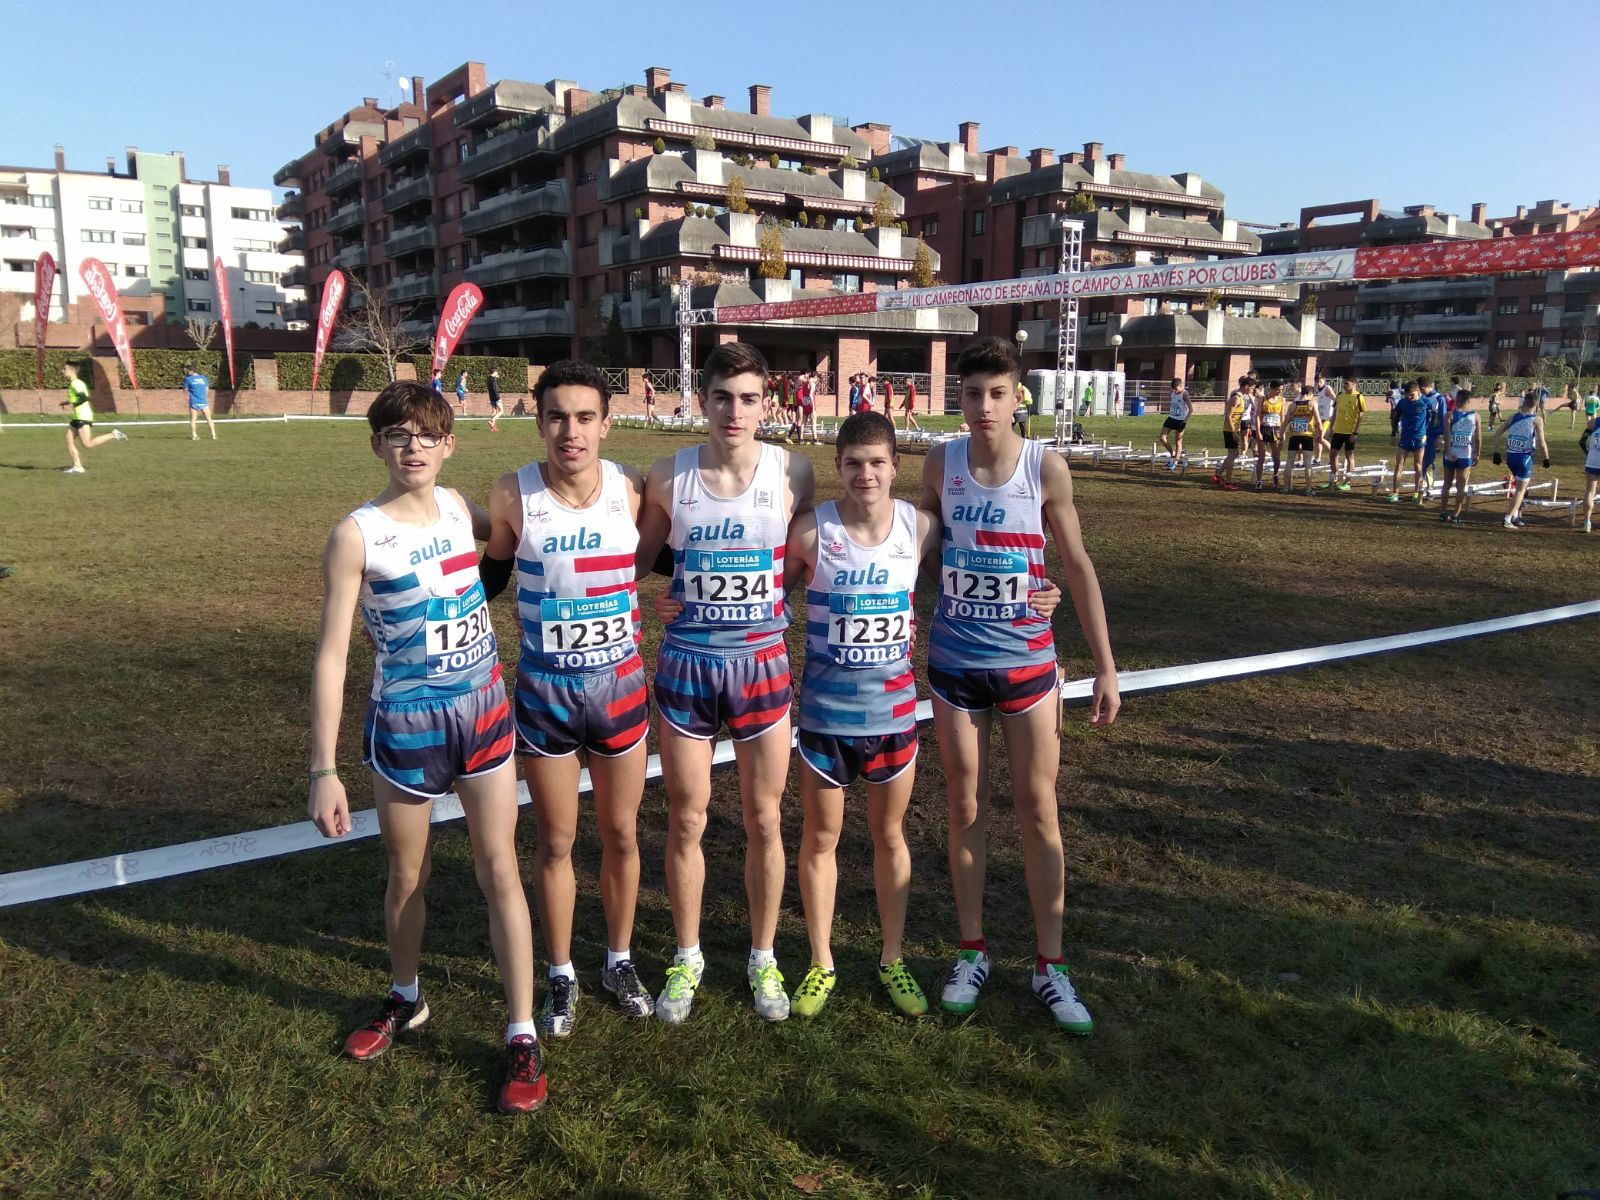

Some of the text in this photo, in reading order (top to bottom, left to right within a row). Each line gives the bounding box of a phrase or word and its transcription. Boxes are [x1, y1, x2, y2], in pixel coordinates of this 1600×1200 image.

[925, 287, 992, 305] CAMPEONATO
[995, 285, 1008, 299] DE
[1010, 279, 1051, 298] ESPAÑA
[1054, 280, 1069, 295] DE
[1072, 274, 1121, 293] CAMPO
[1123, 276, 1134, 289] A
[1137, 266, 1184, 288] TRAVÉS
[1188, 267, 1217, 285] POR
[1221, 262, 1277, 282] CLUBES
[445, 288, 479, 338] Coca-Cola
[1508, 439, 1527, 448] 1092
[952, 501, 1006, 525] aula
[542, 527, 602, 553] aula
[688, 517, 745, 542] aula
[409, 537, 452, 566] aula
[716, 554, 760, 564] LOTERÍAS
[971, 555, 1014, 565] LOTERÍAS
[833, 562, 889, 586] aula
[948, 571, 1018, 601] 1231
[690, 574, 769, 602] 1234
[576, 599, 619, 612] LOTERÍAS
[860, 597, 900, 606] LOTERÍAS
[434, 606, 488, 650] 1230
[549, 616, 628, 650] 1233
[835, 614, 906, 643] 1232
